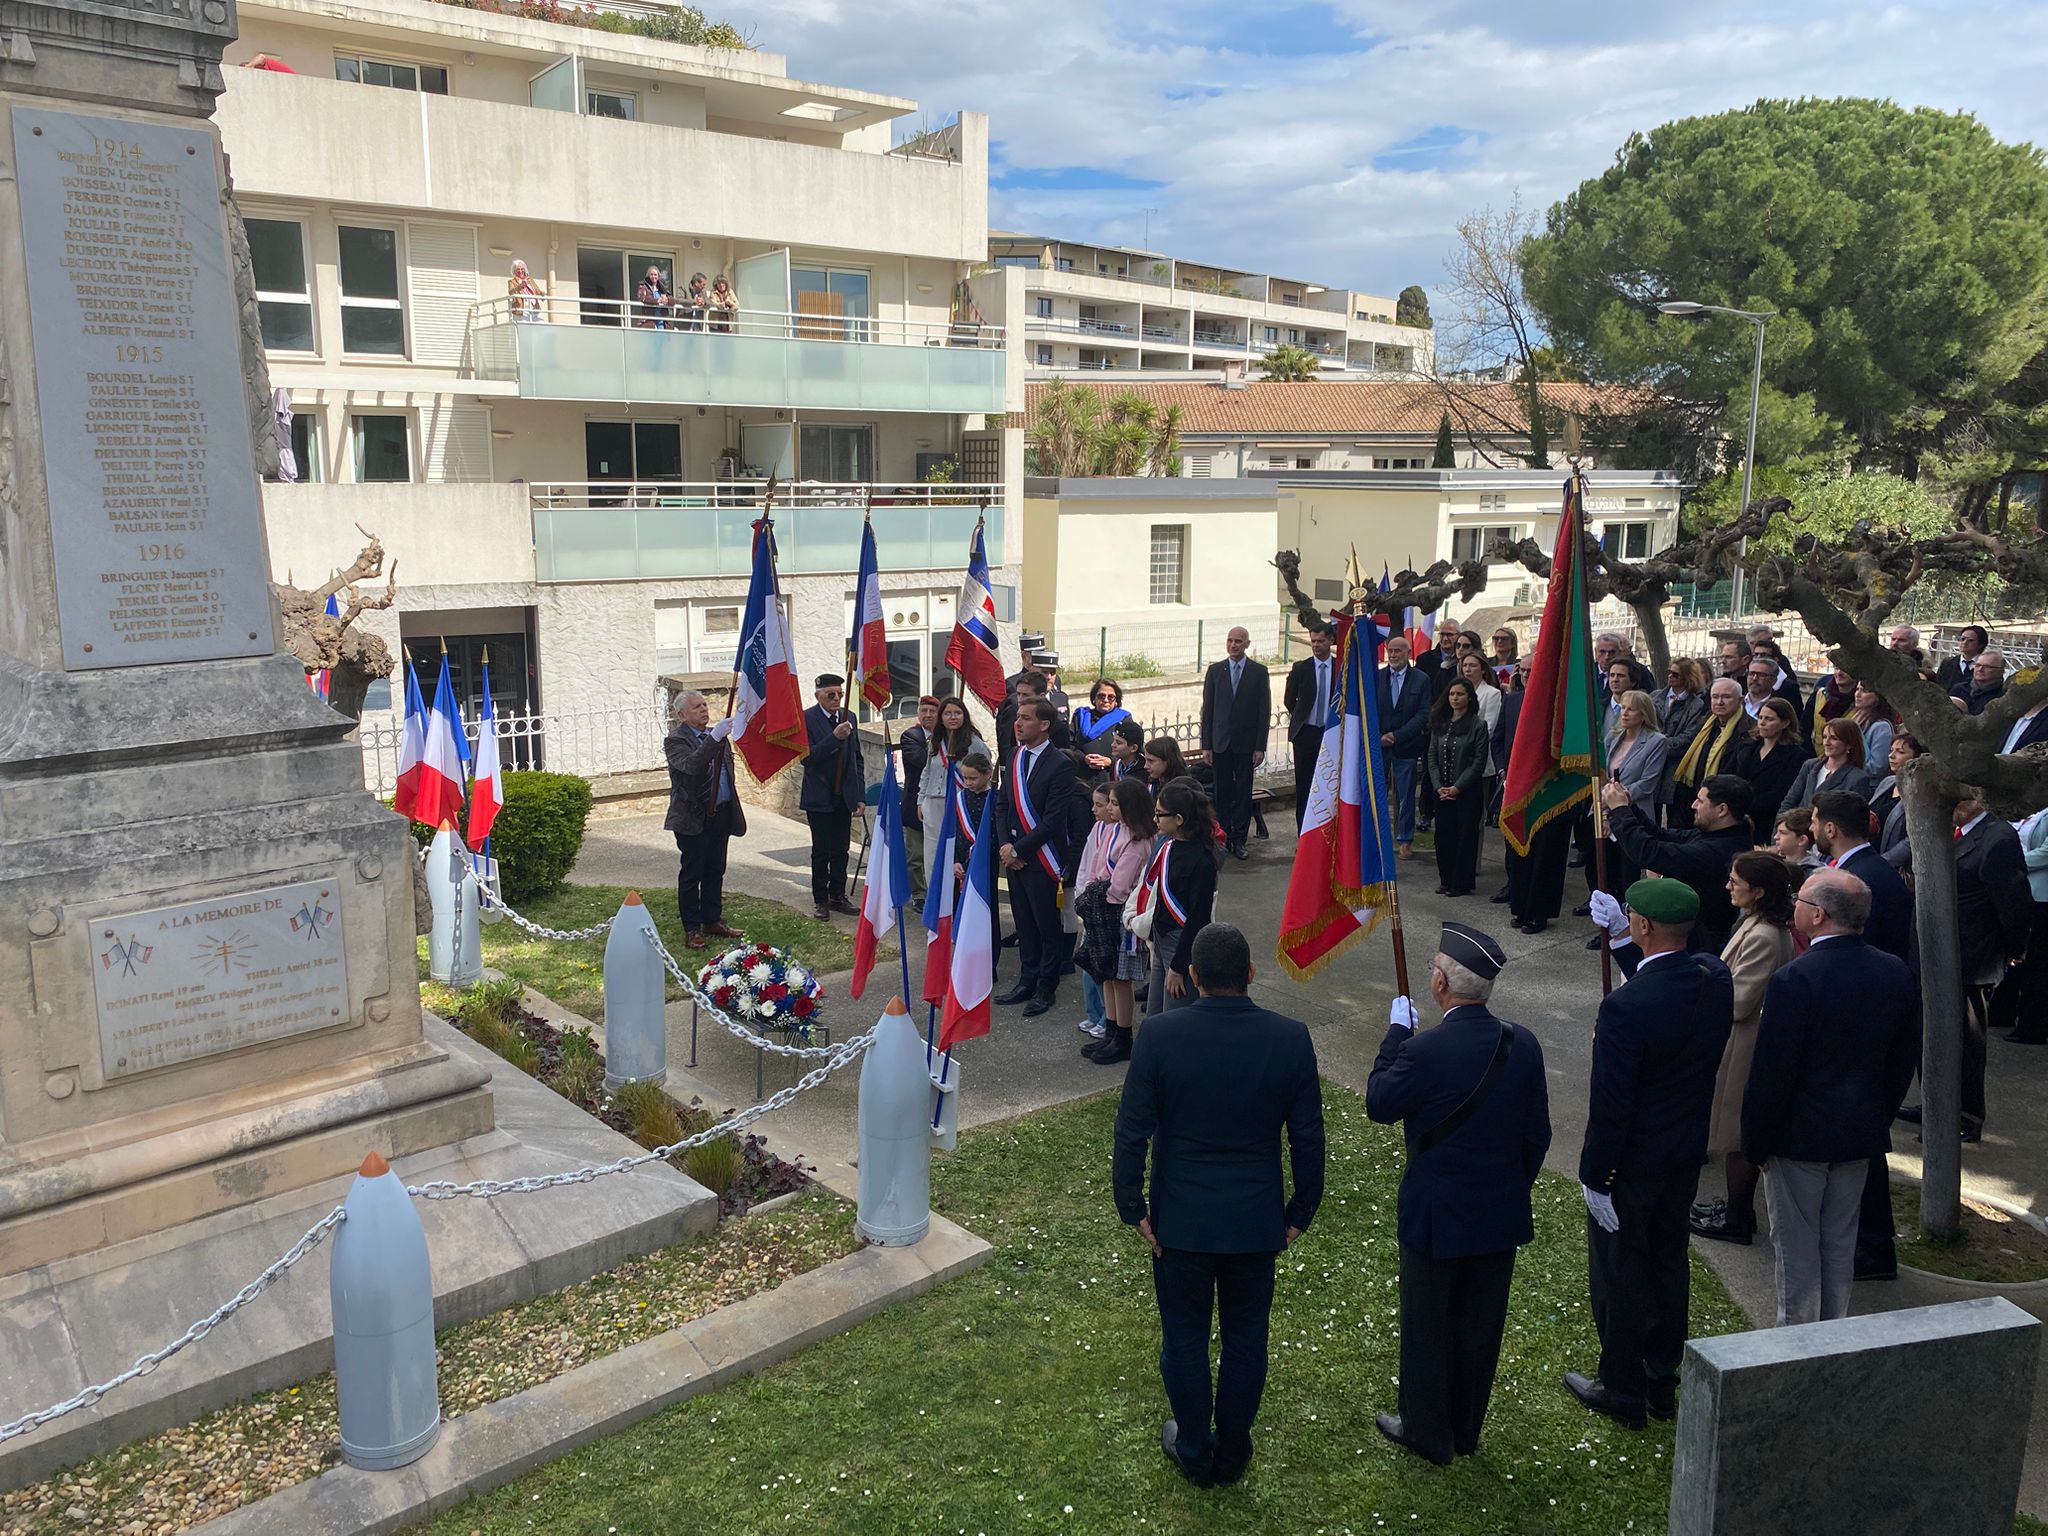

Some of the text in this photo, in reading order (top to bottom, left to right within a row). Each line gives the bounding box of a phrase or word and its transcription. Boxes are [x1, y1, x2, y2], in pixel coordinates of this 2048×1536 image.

[93, 137, 142, 160] 1914
[62, 176, 126, 193] BOISSEAU
[130, 184, 162, 196] Albert
[66, 191, 121, 205] FERRIER
[125, 197, 160, 208] Octave
[63, 204, 119, 218] DAUMAS
[64, 231, 137, 246] ROUSSELET
[141, 237, 172, 248] André
[131, 249, 173, 263] Auguste
[69, 272, 141, 285] MOURGUES
[145, 276, 175, 287] Pierre
[76, 285, 147, 298] BRINGUIER
[150, 290, 172, 300] Paul
[77, 298, 175, 313] TEIXIDOR Ernest
[84, 312, 145, 324] CHARRAS
[149, 315, 171, 325] Jean
[82, 325, 132, 336] ALBERT
[135, 327, 176, 338] Fernand
[116, 345, 163, 363] 1915
[87, 372, 146, 384] BOURDEL
[149, 374, 177, 384] Louis
[91, 386, 140, 396] PAULHE
[144, 387, 176, 398] Joseph
[88, 399, 149, 408] GINESTET
[152, 400, 180, 409] Emile
[86, 411, 151, 421] GARRIGUE
[154, 412, 187, 423] Joseph
[85, 424, 139, 433] LIONNET
[143, 425, 190, 435] Raymond
[96, 437, 152, 446] REBELLE
[95, 449, 152, 458] DELTOUR
[155, 449, 188, 460] Joseph
[101, 462, 152, 471] DELTEIL
[154, 461, 184, 470] Pierre
[104, 474, 151, 483] THIBAL
[154, 473, 184, 483] André
[102, 486, 157, 496] BERNIER
[159, 485, 189, 495] André
[103, 498, 168, 508] AZAUBERT
[171, 497, 192, 507] Paul
[109, 510, 157, 520] BALSAN
[161, 510, 188, 519] Henri
[114, 522, 162, 533] PAULHE
[164, 522, 186, 531] Jean
[140, 543, 185, 561] 1916
[101, 571, 168, 583] BRINGUIER
[171, 571, 208, 580] Jacques
[121, 583, 160, 594] FLORY
[164, 583, 192, 592] Henri
[117, 595, 159, 607] TERME
[161, 594, 198, 604] Charles
[109, 608, 168, 620] PELISSIER
[171, 606, 208, 616] Camille
[113, 620, 170, 631] LAFFONT
[171, 619, 208, 628] Etienne
[124, 631, 170, 643] ALBERT
[172, 630, 201, 639] André
[159, 898, 283, 930] A LA MEMOIRE DE
